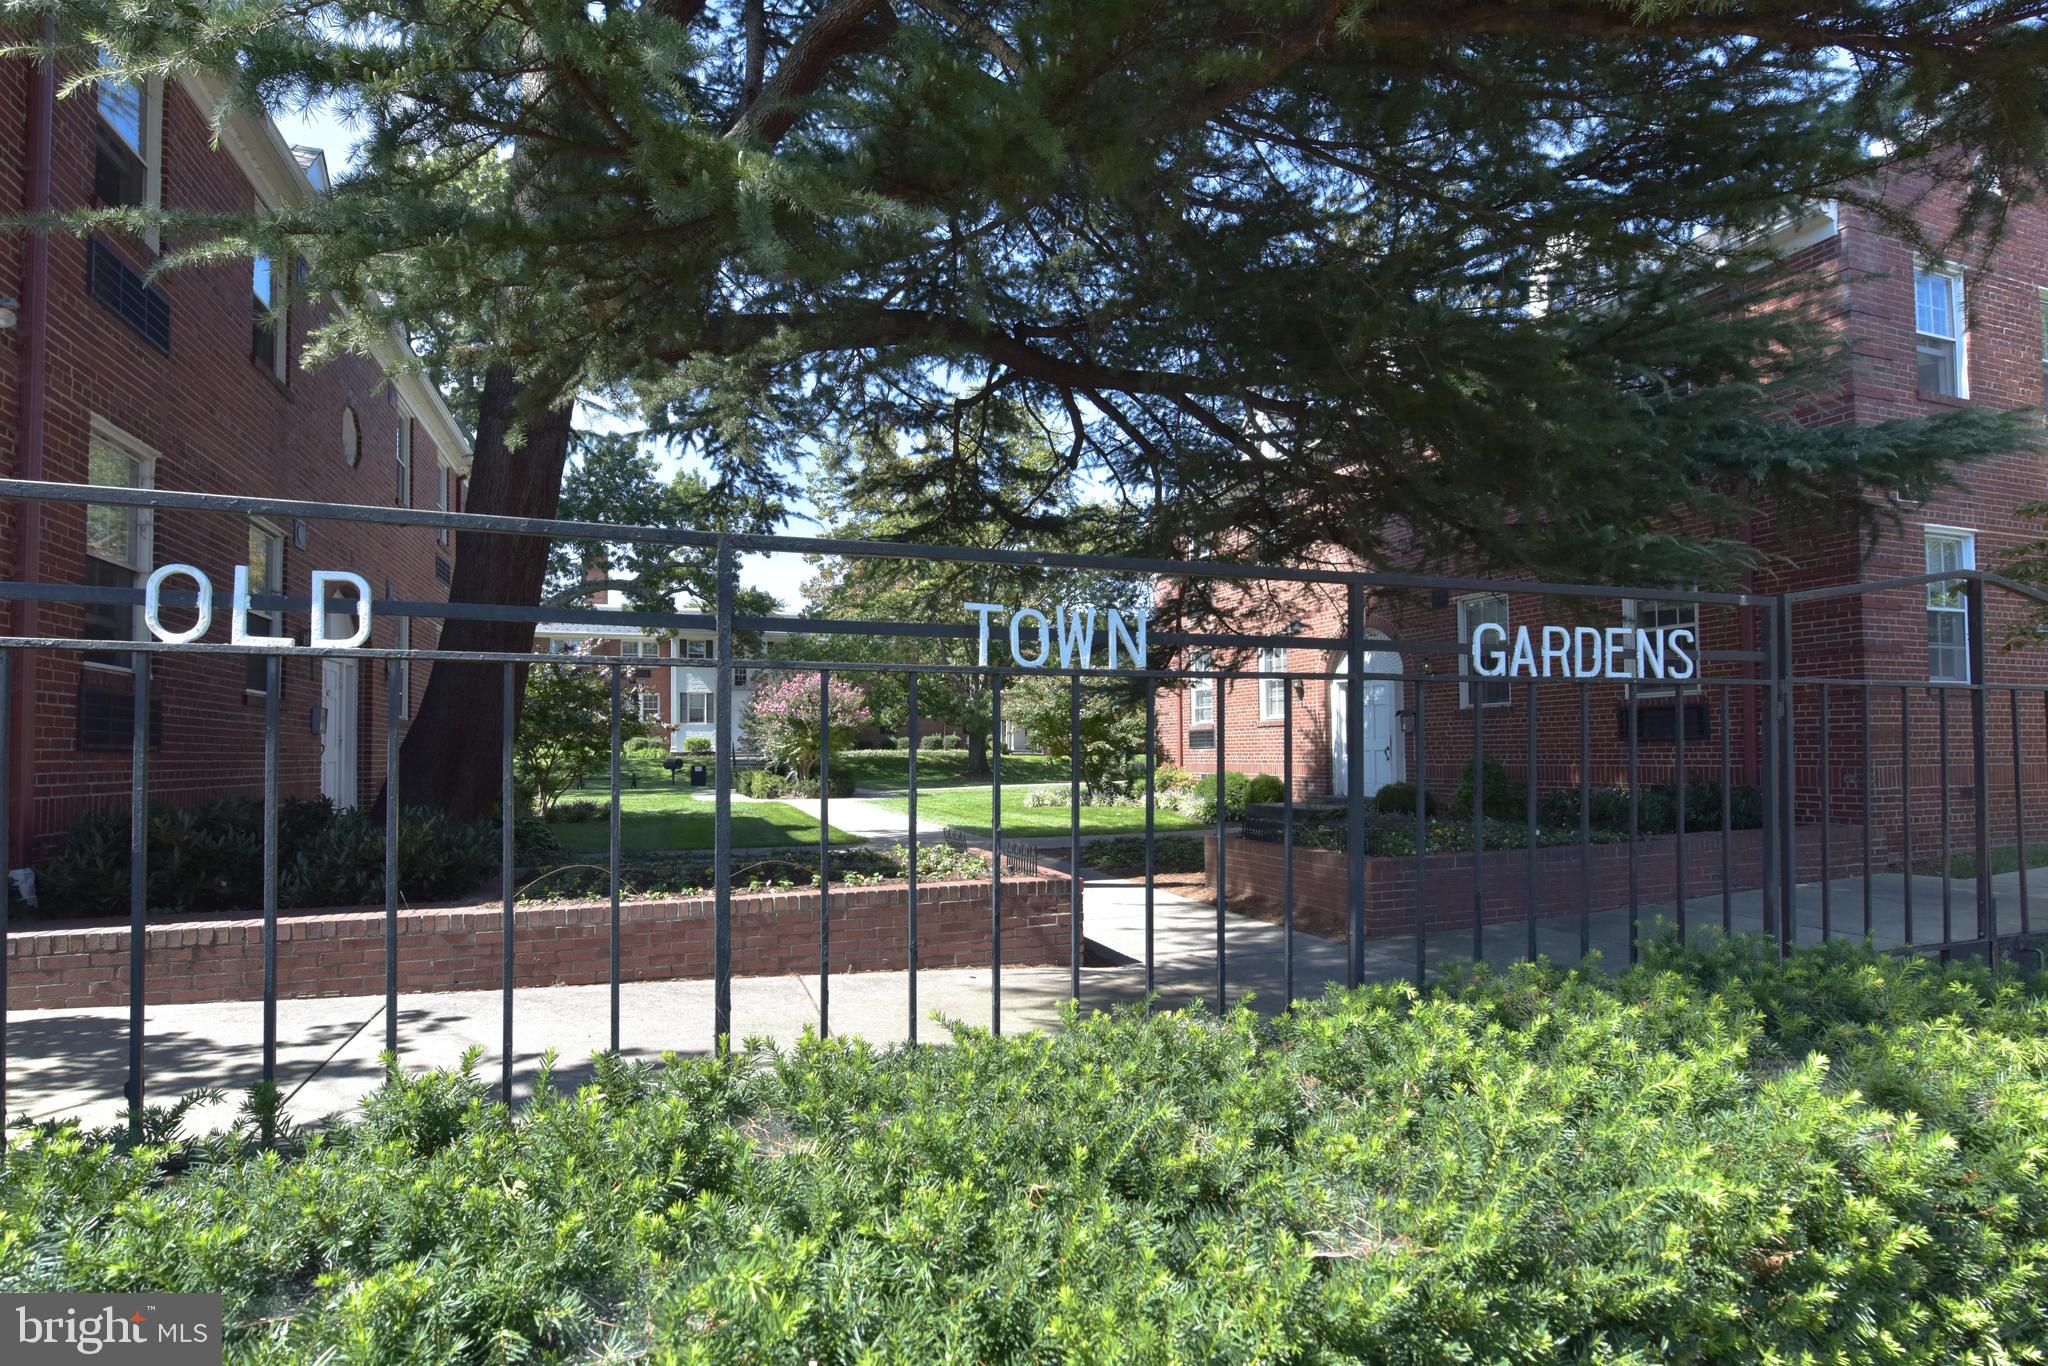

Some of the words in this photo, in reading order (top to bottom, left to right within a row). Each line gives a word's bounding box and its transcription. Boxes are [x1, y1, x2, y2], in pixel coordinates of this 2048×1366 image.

[145, 563, 371, 648] OLD
[963, 602, 1147, 670] TOWN
[1472, 623, 1694, 679] GARDENS
